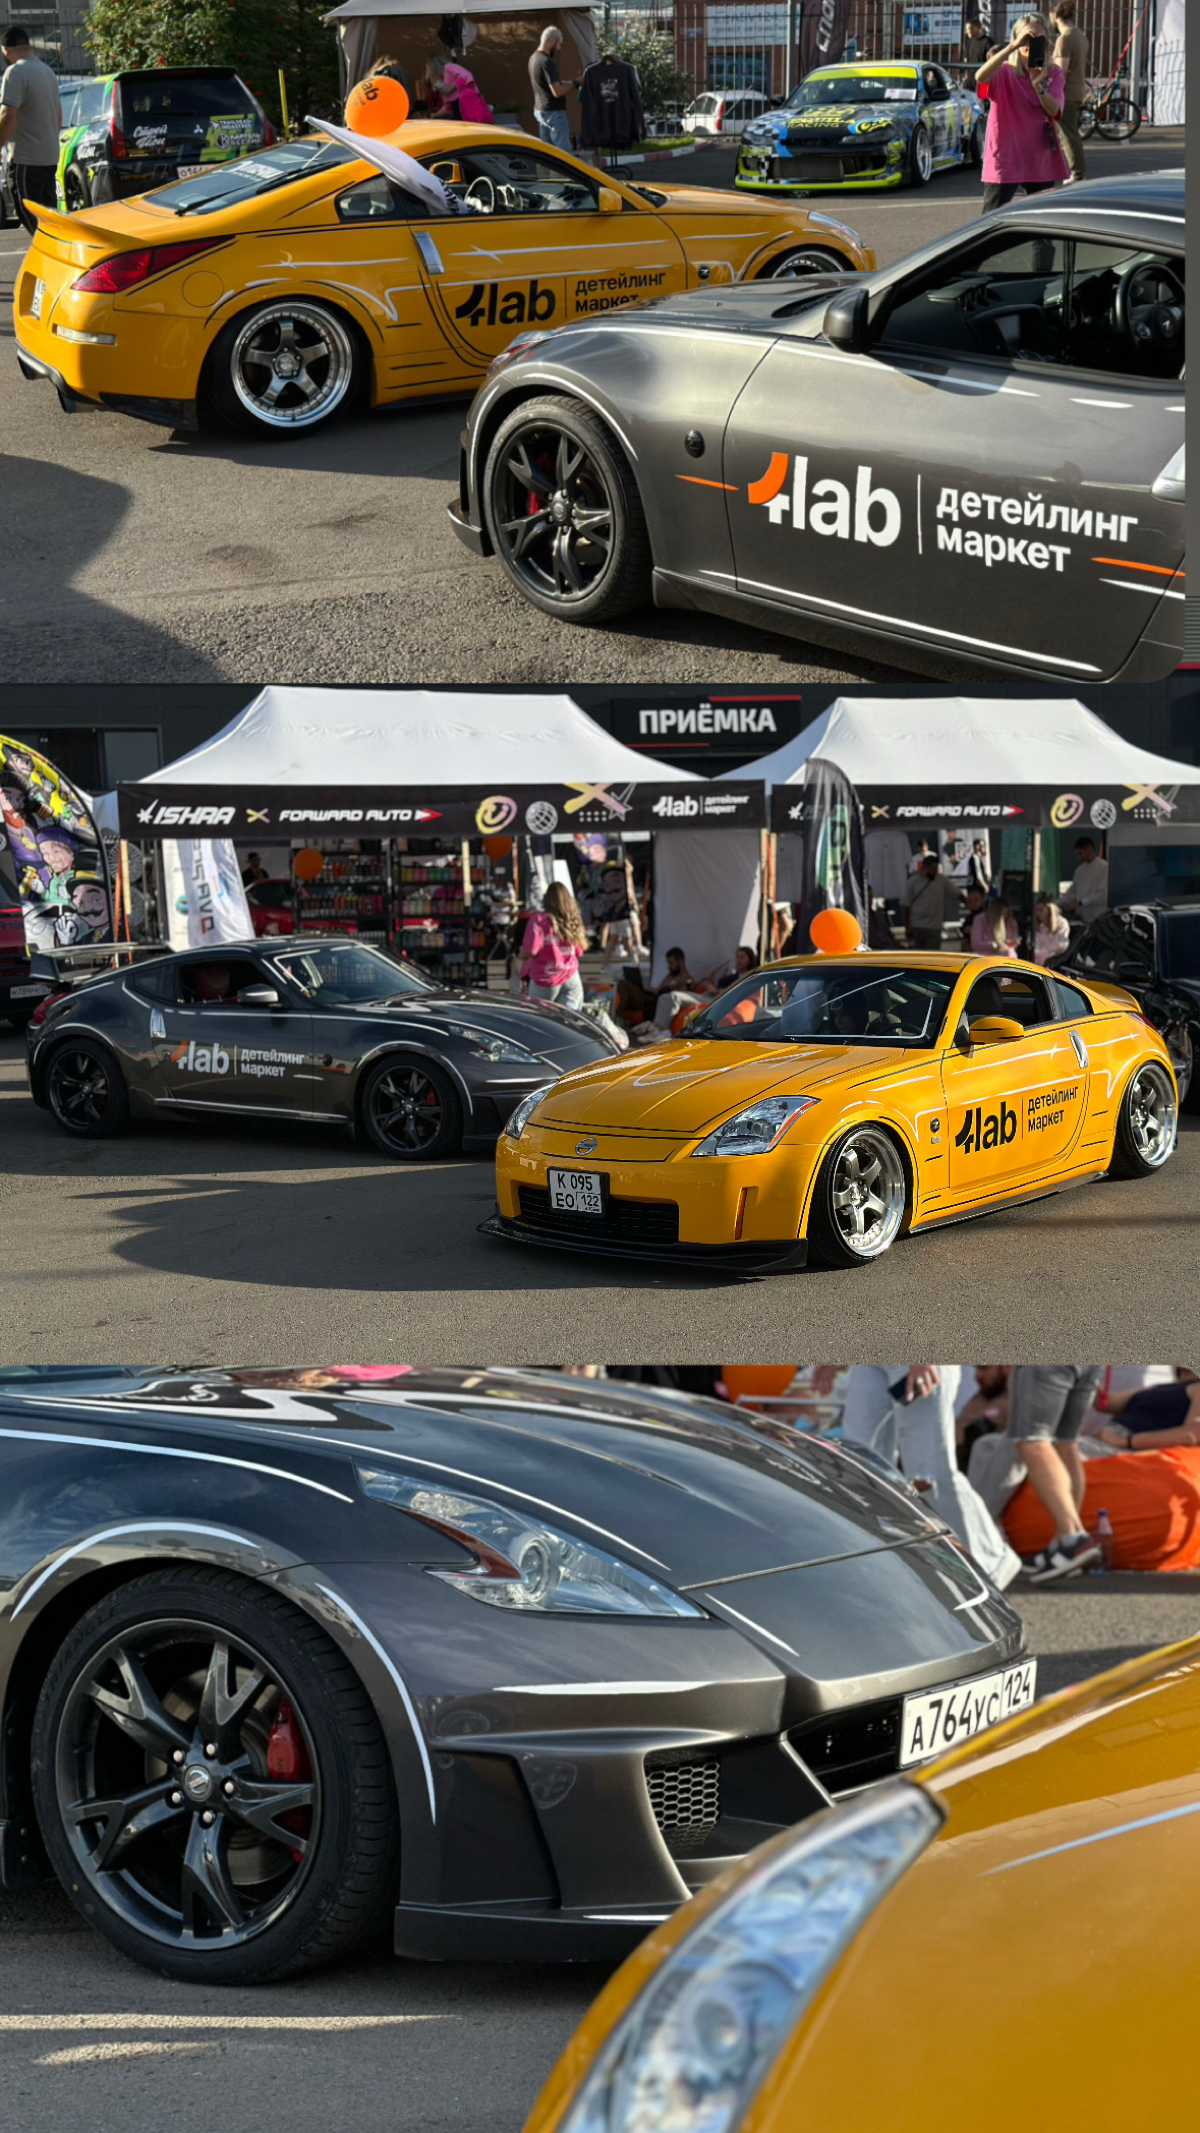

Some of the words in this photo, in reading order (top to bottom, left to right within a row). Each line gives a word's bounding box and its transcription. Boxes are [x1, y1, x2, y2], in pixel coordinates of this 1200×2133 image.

[575, 273, 666, 297] детейлинг
[455, 280, 556, 327] 4lab
[748, 452, 901, 547] 4lab
[936, 487, 1138, 543] детейлинг
[936, 524, 1071, 572] маркет
[638, 703, 777, 734] ПРИЁМКА
[152, 806, 236, 825] ISHRA
[279, 810, 363, 821] FORWARD
[365, 810, 413, 821] AUTO
[896, 805, 963, 817] FORWARD
[963, 805, 1001, 816] AUTO
[171, 1040, 229, 1074] 4lab
[241, 1048, 305, 1065] детейлинг
[241, 1063, 285, 1077] маркет
[1028, 1086, 1079, 1115] детейлинг
[955, 1101, 1017, 1154] 4lab
[1028, 1109, 1065, 1132] маркет
[570, 1173, 593, 1191] 095
[581, 1193, 600, 1207] 122
[1005, 1667, 1031, 1709] 124
